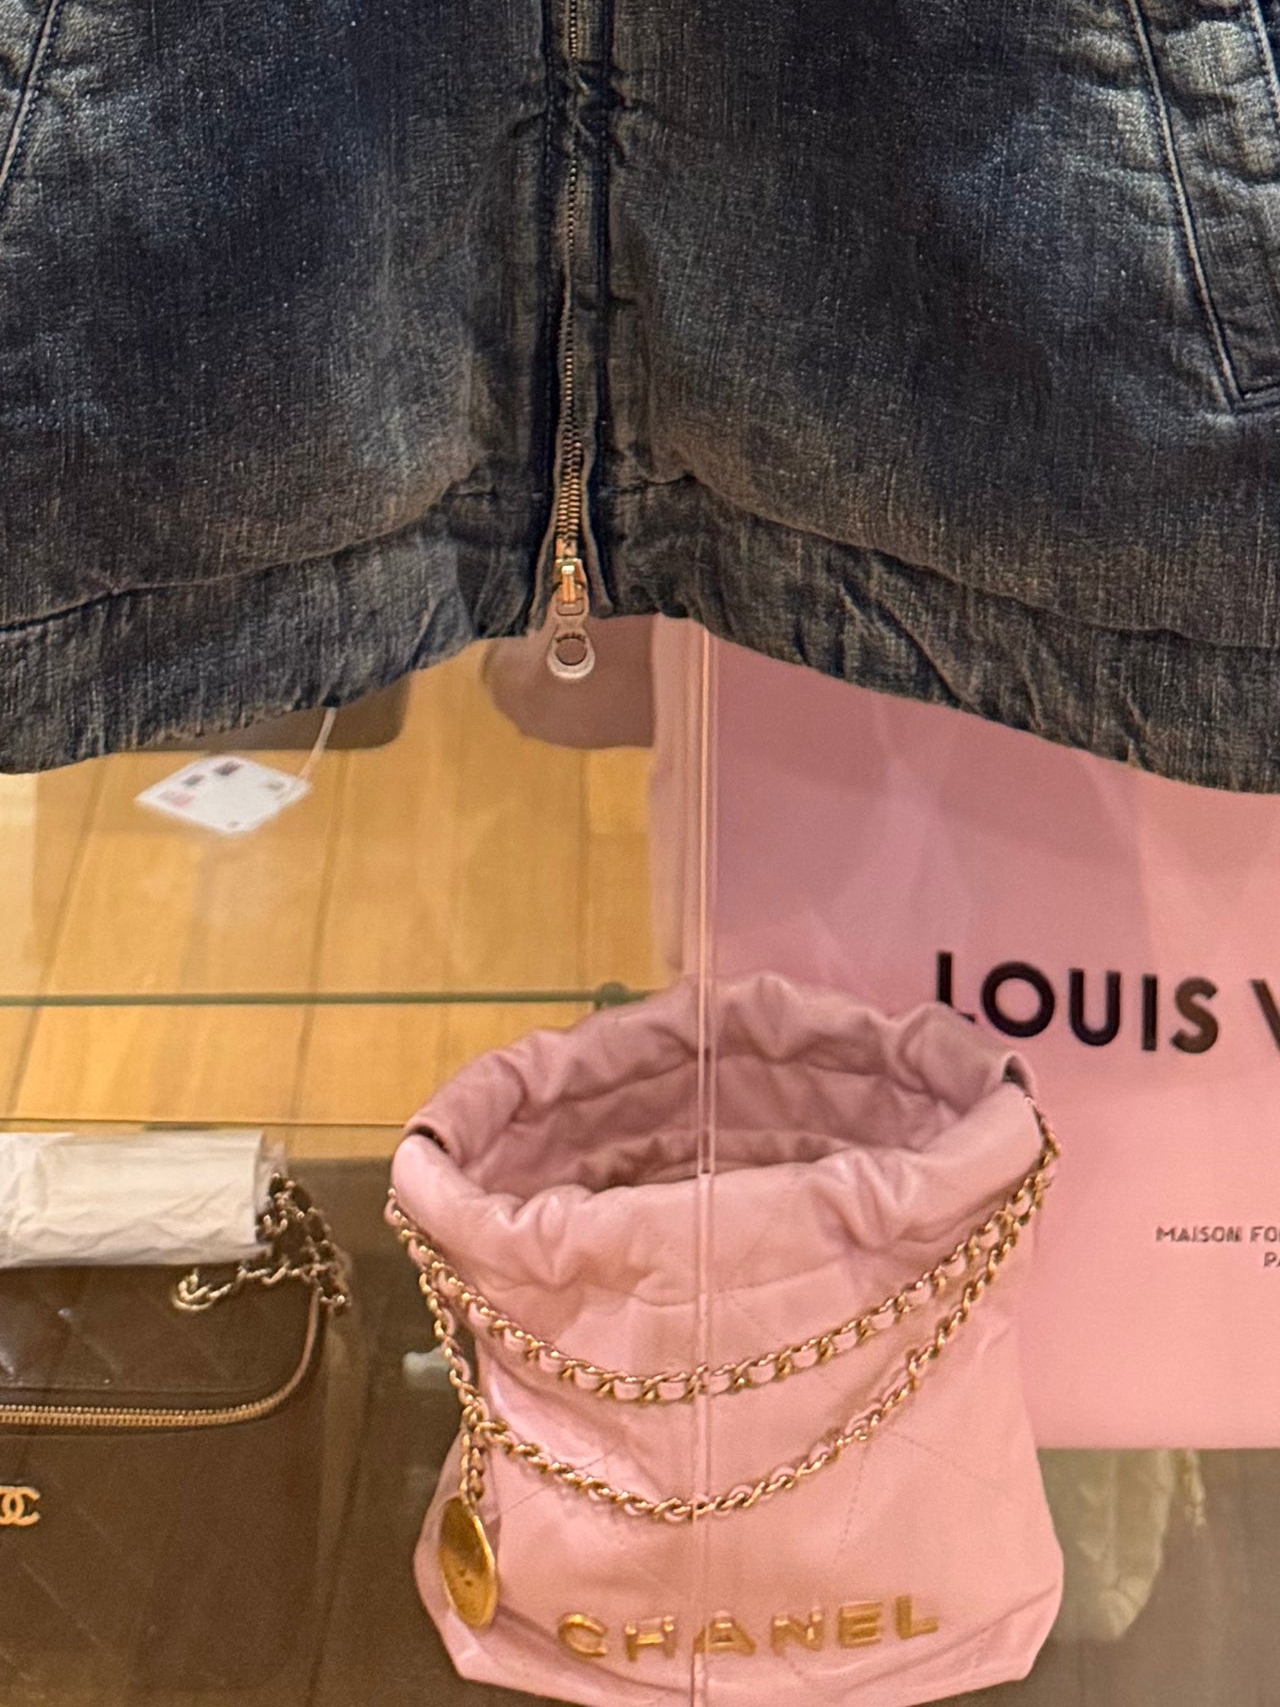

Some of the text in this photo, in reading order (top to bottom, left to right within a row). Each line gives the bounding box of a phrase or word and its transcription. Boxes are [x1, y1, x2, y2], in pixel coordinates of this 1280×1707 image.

[935, 950, 1219, 1055] LOUIS
[1154, 1225, 1242, 1243] MAISON
[557, 1594, 940, 1662] CHANEL
